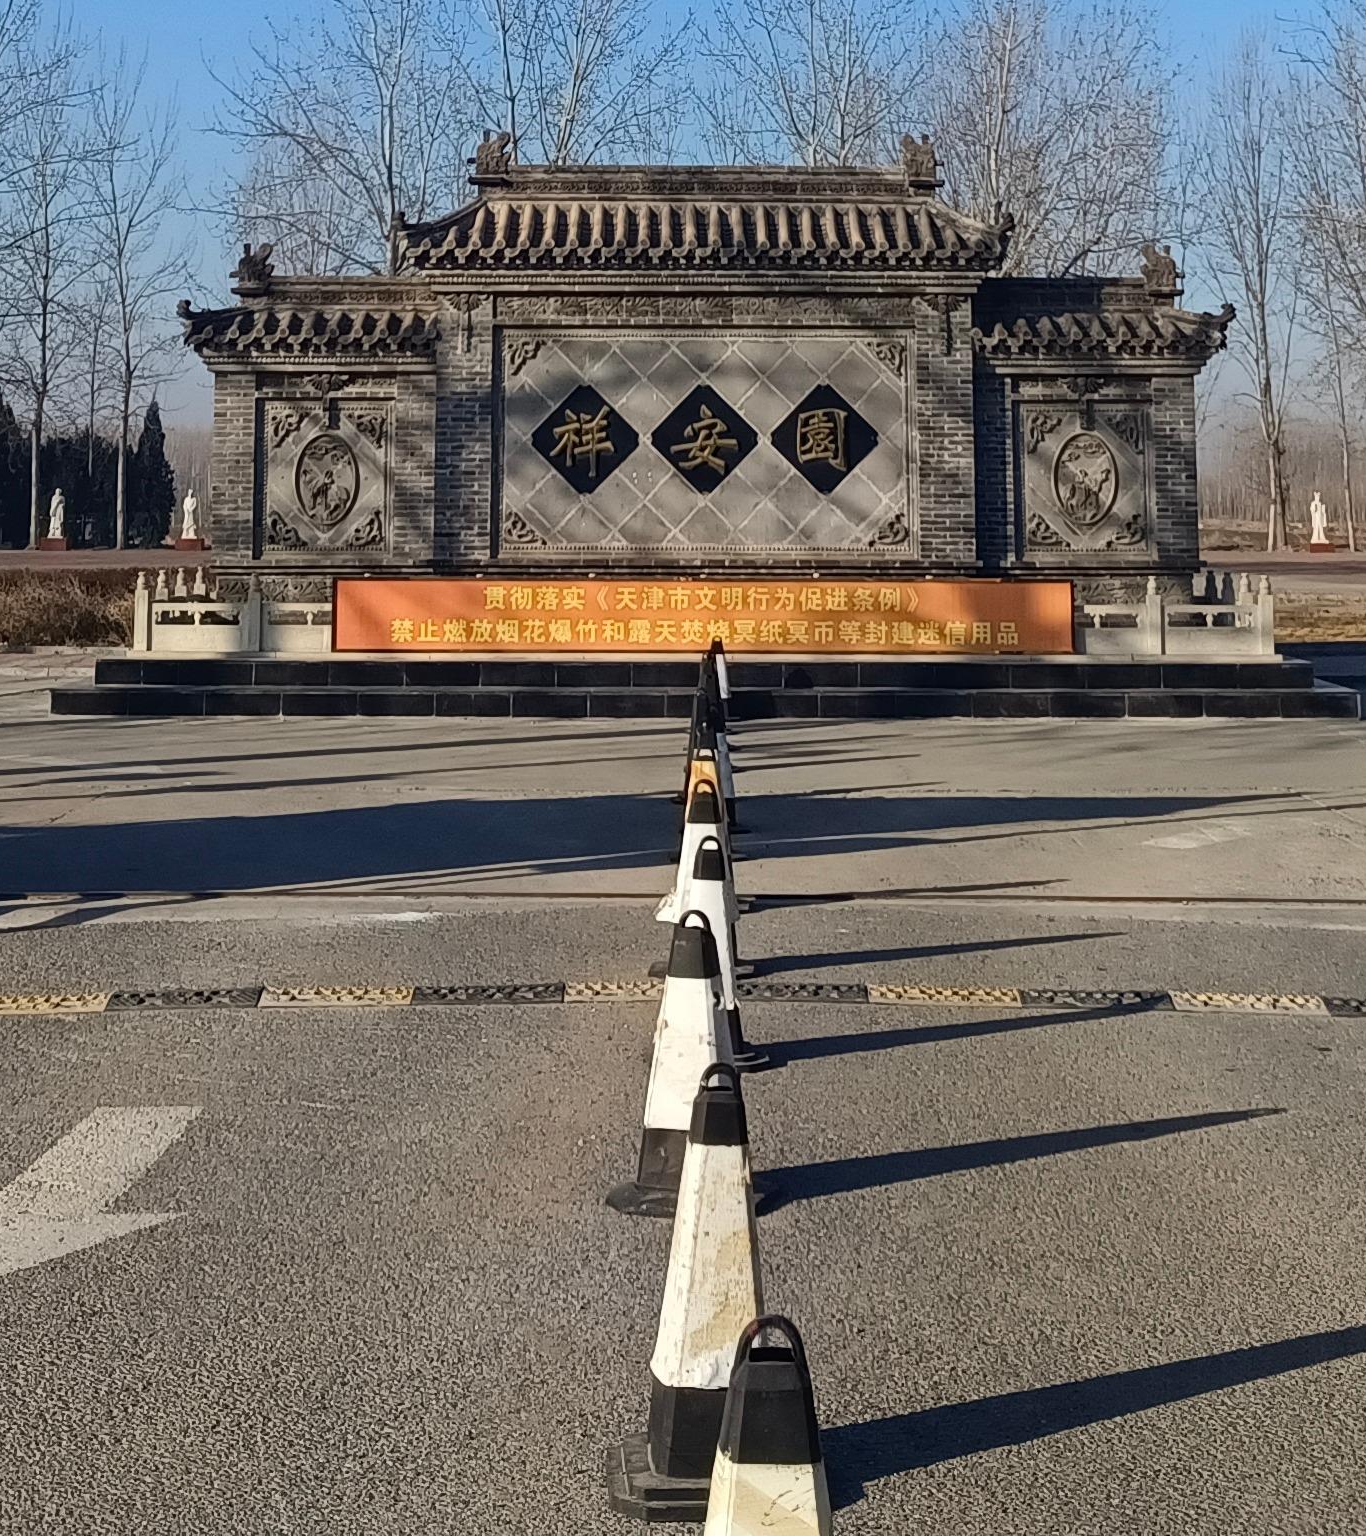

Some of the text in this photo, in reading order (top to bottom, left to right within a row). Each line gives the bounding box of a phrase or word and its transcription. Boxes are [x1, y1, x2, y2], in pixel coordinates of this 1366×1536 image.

[483, 585, 921, 613] 贯彻落实《天津市文明行为促进条例》
[390, 618, 1020, 646] 禁止燃放烟花爆竹和露天焚烧冥纸冥币等封建迷信用品
